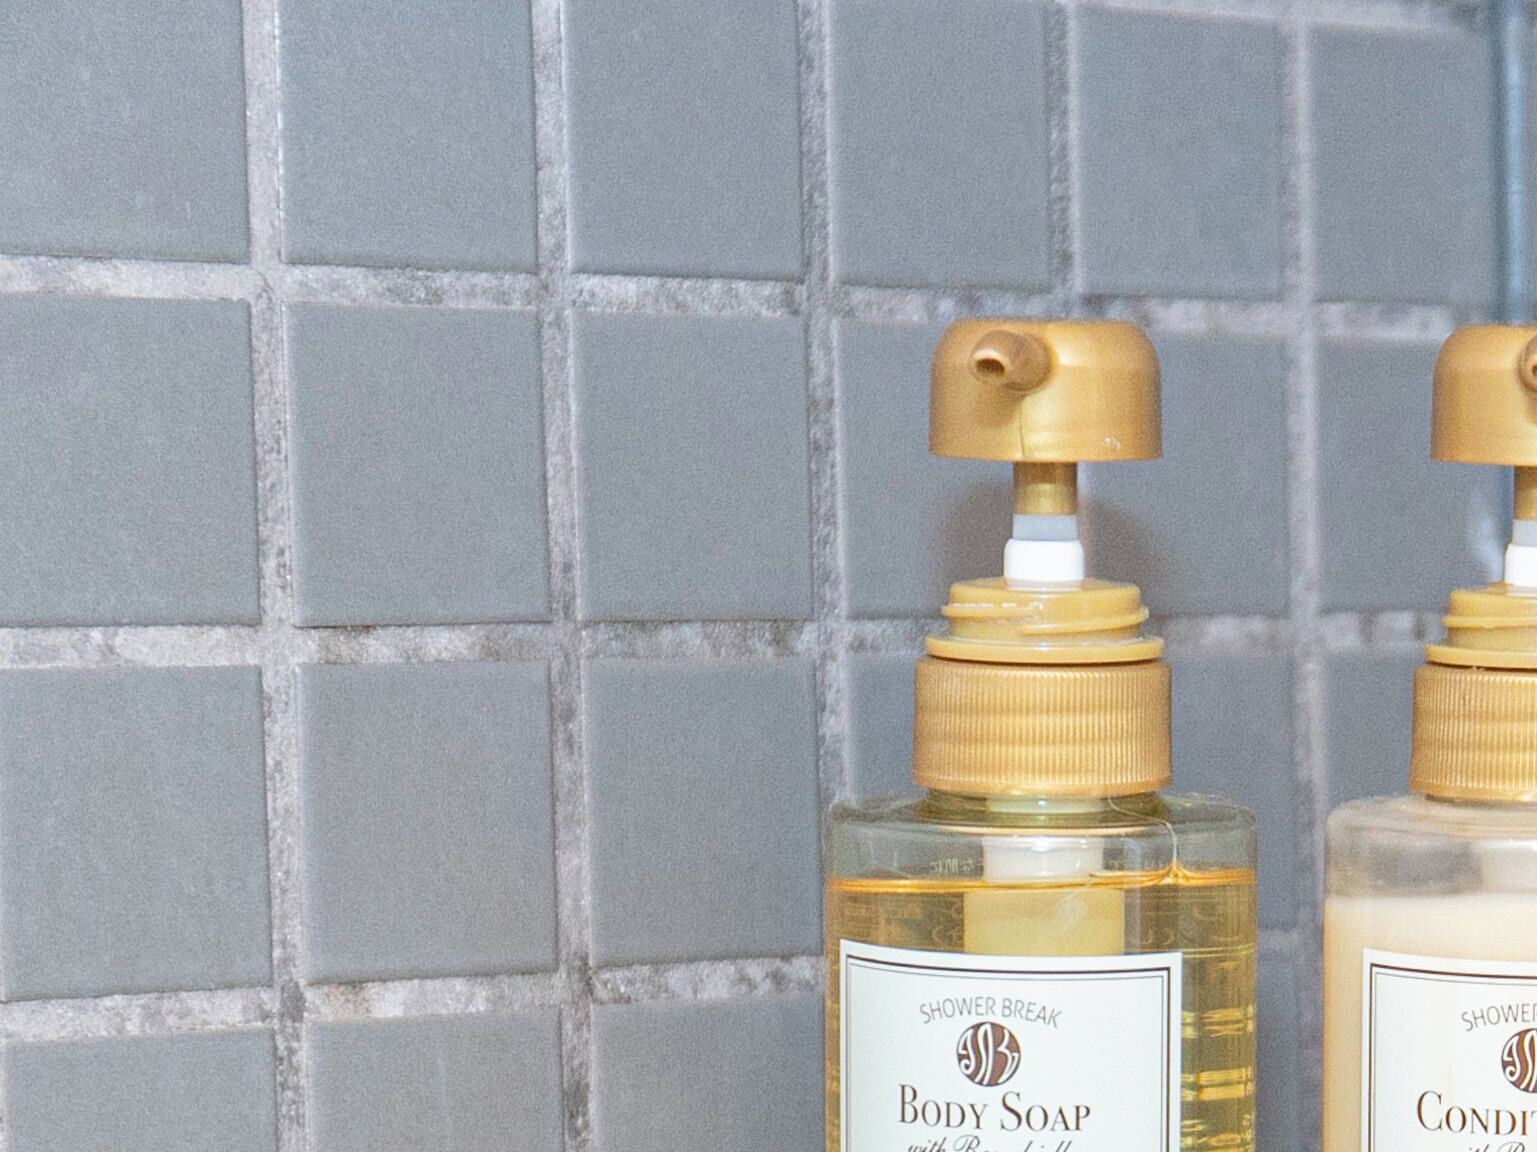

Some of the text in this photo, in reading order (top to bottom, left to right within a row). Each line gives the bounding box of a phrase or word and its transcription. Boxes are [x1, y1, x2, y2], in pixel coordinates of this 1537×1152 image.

[920, 996, 1063, 1029] SHOWER BREAK
[899, 1084, 1090, 1132] BODY SOAP
